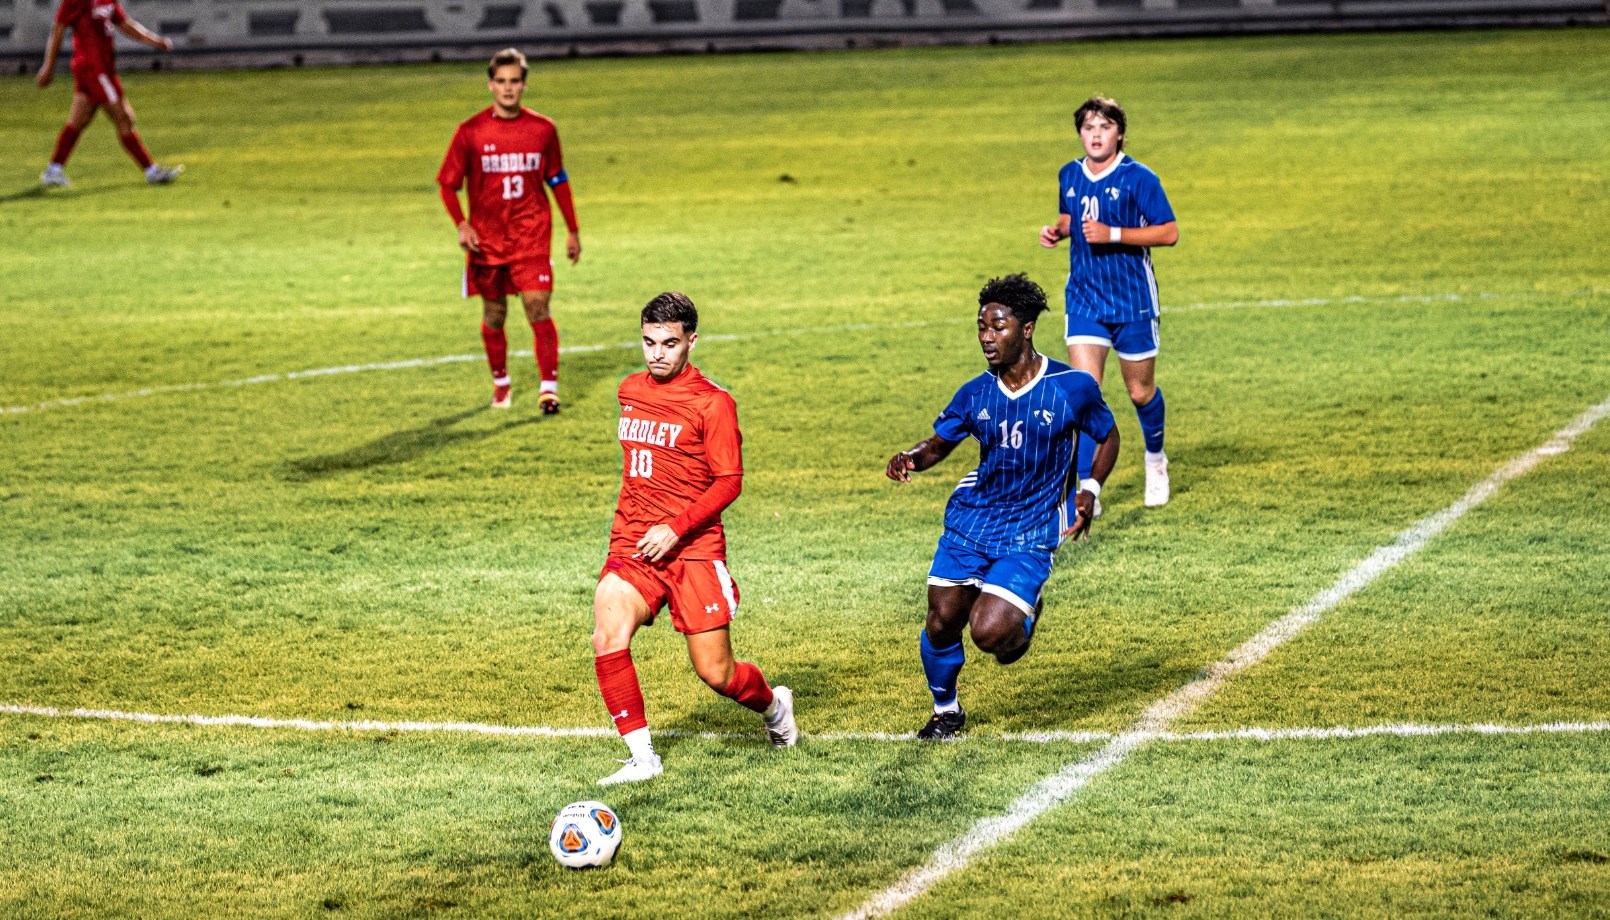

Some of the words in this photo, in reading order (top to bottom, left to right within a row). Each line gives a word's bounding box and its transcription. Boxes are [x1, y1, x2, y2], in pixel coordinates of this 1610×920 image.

[481, 152, 541, 173] BRADLEY
[502, 175, 524, 200] 13
[1081, 195, 1099, 222] 20
[999, 420, 1023, 449] 16
[630, 448, 652, 478] 10
